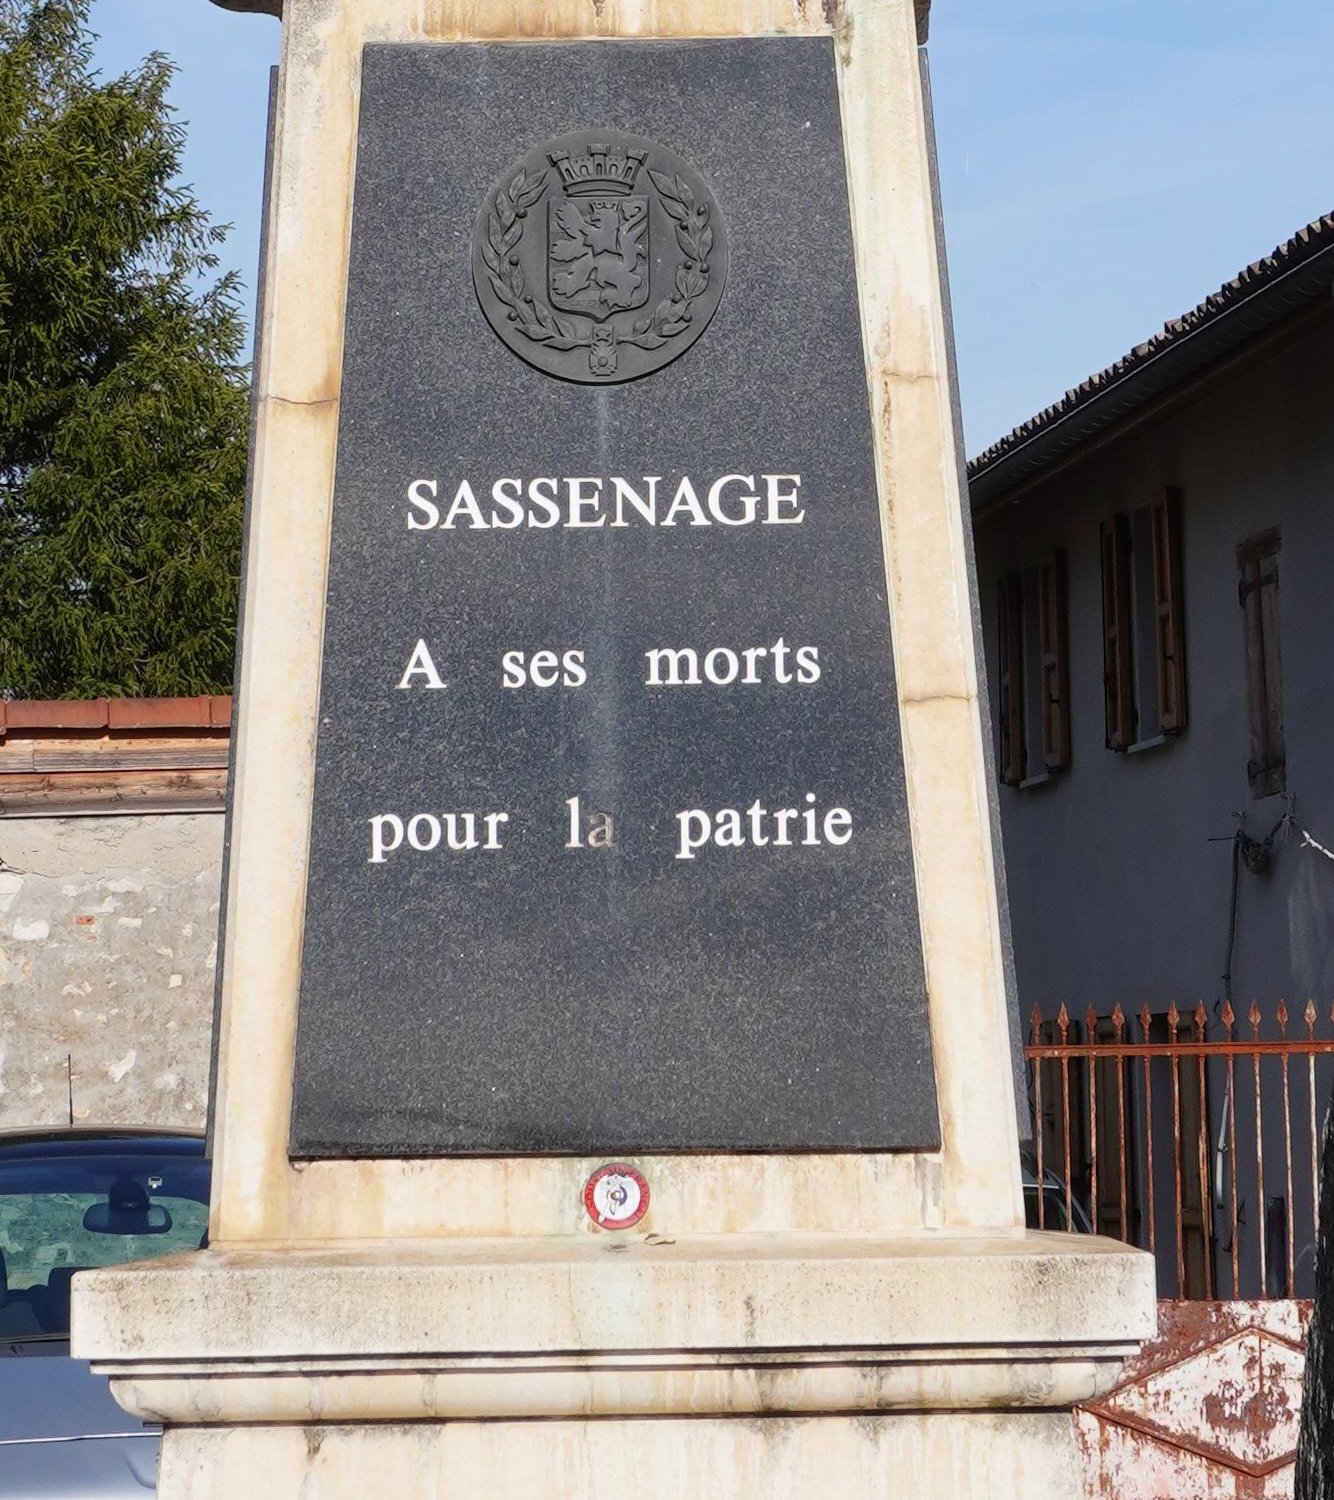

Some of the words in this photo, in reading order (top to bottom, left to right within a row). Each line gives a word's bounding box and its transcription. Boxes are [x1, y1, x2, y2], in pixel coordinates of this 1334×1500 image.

[407, 473, 806, 531] SASSENAGE
[394, 638, 448, 690] A
[501, 649, 587, 689] ses
[644, 636, 821, 686] morts
[366, 811, 509, 865] pour
[564, 795, 616, 850] la
[674, 792, 854, 860] patrie
